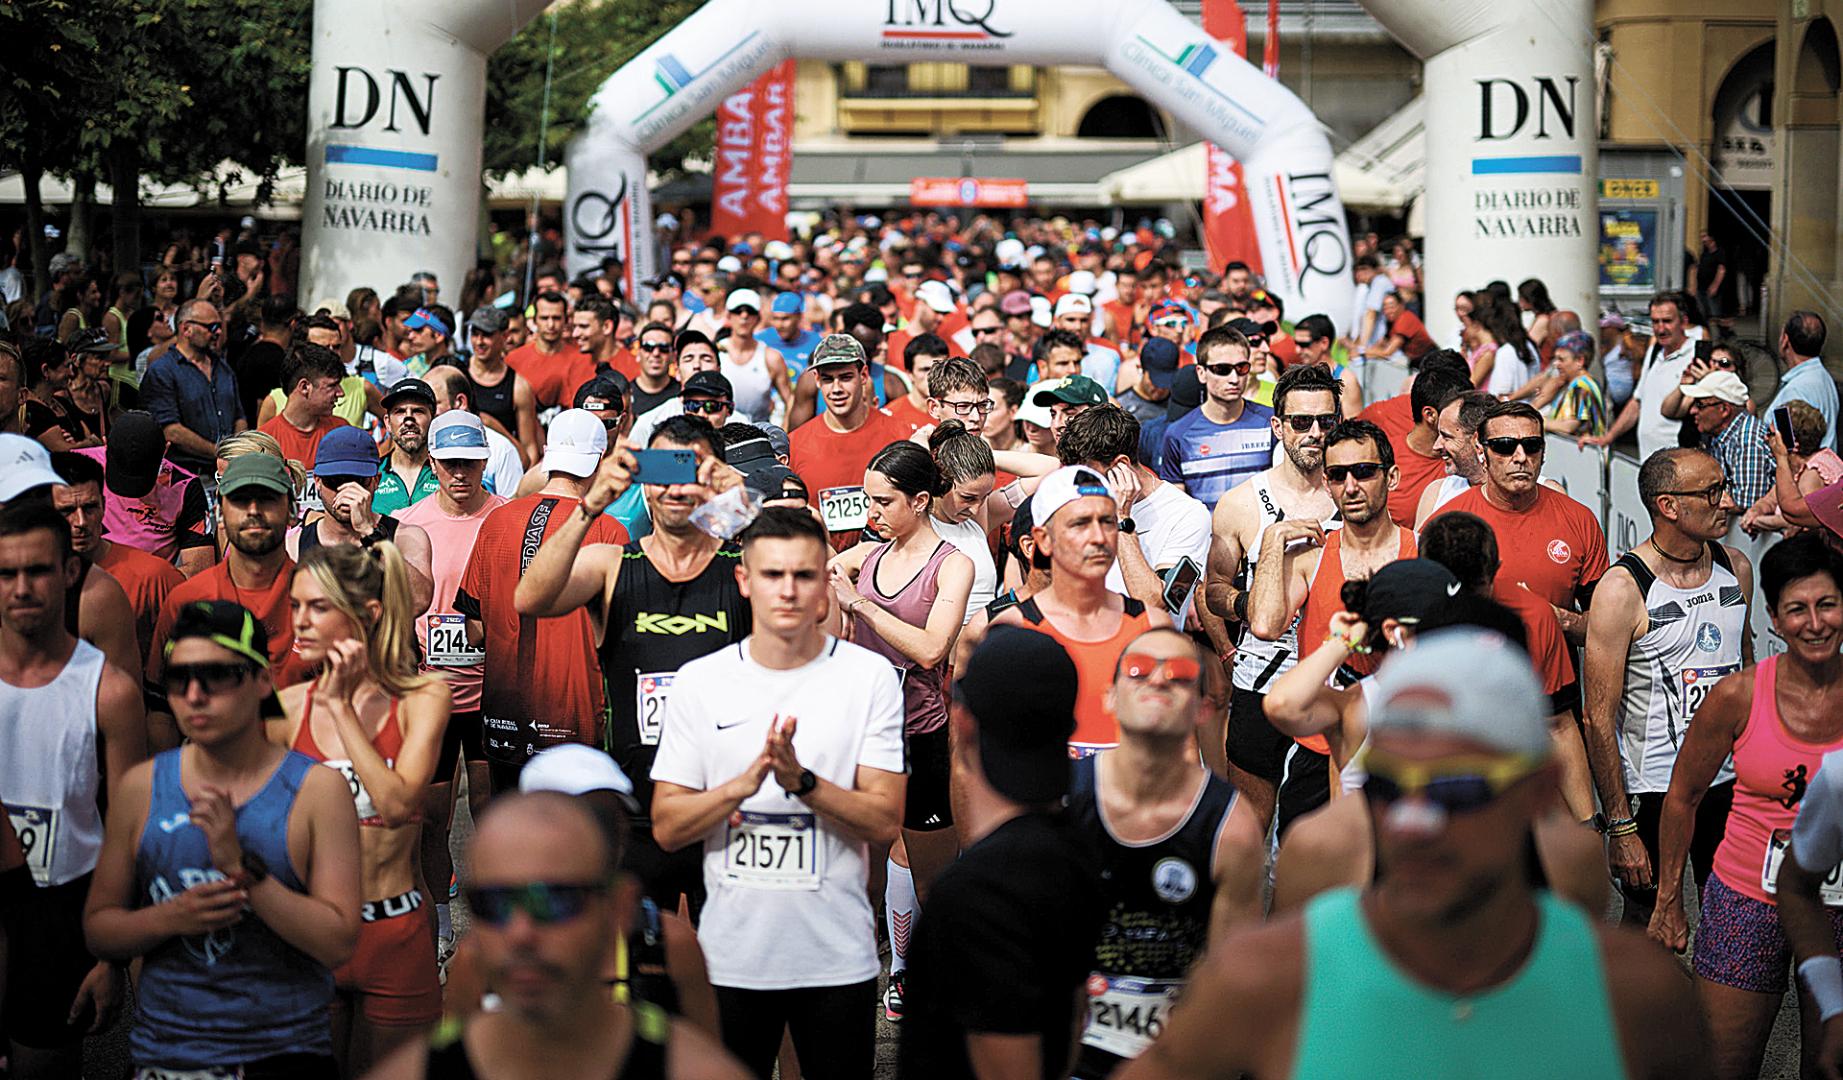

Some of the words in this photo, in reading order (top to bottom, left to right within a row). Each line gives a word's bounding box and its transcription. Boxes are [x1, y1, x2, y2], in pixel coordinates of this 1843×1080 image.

[328, 66, 442, 136] DN
[1473, 76, 1580, 141] DN
[325, 178, 398, 204] DIARIO
[402, 185, 433, 208] DE
[1474, 190, 1551, 211] DIARIO
[1555, 187, 1581, 210] DE
[322, 203, 432, 236] NAVARRA
[1288, 173, 1347, 299] IMQ
[1475, 214, 1582, 239] NAVARRA
[1258, 488, 1278, 517] soar
[520, 503, 551, 577] EDIASF
[735, 831, 804, 869] 21571
[1094, 1001, 1170, 1041] 2146
